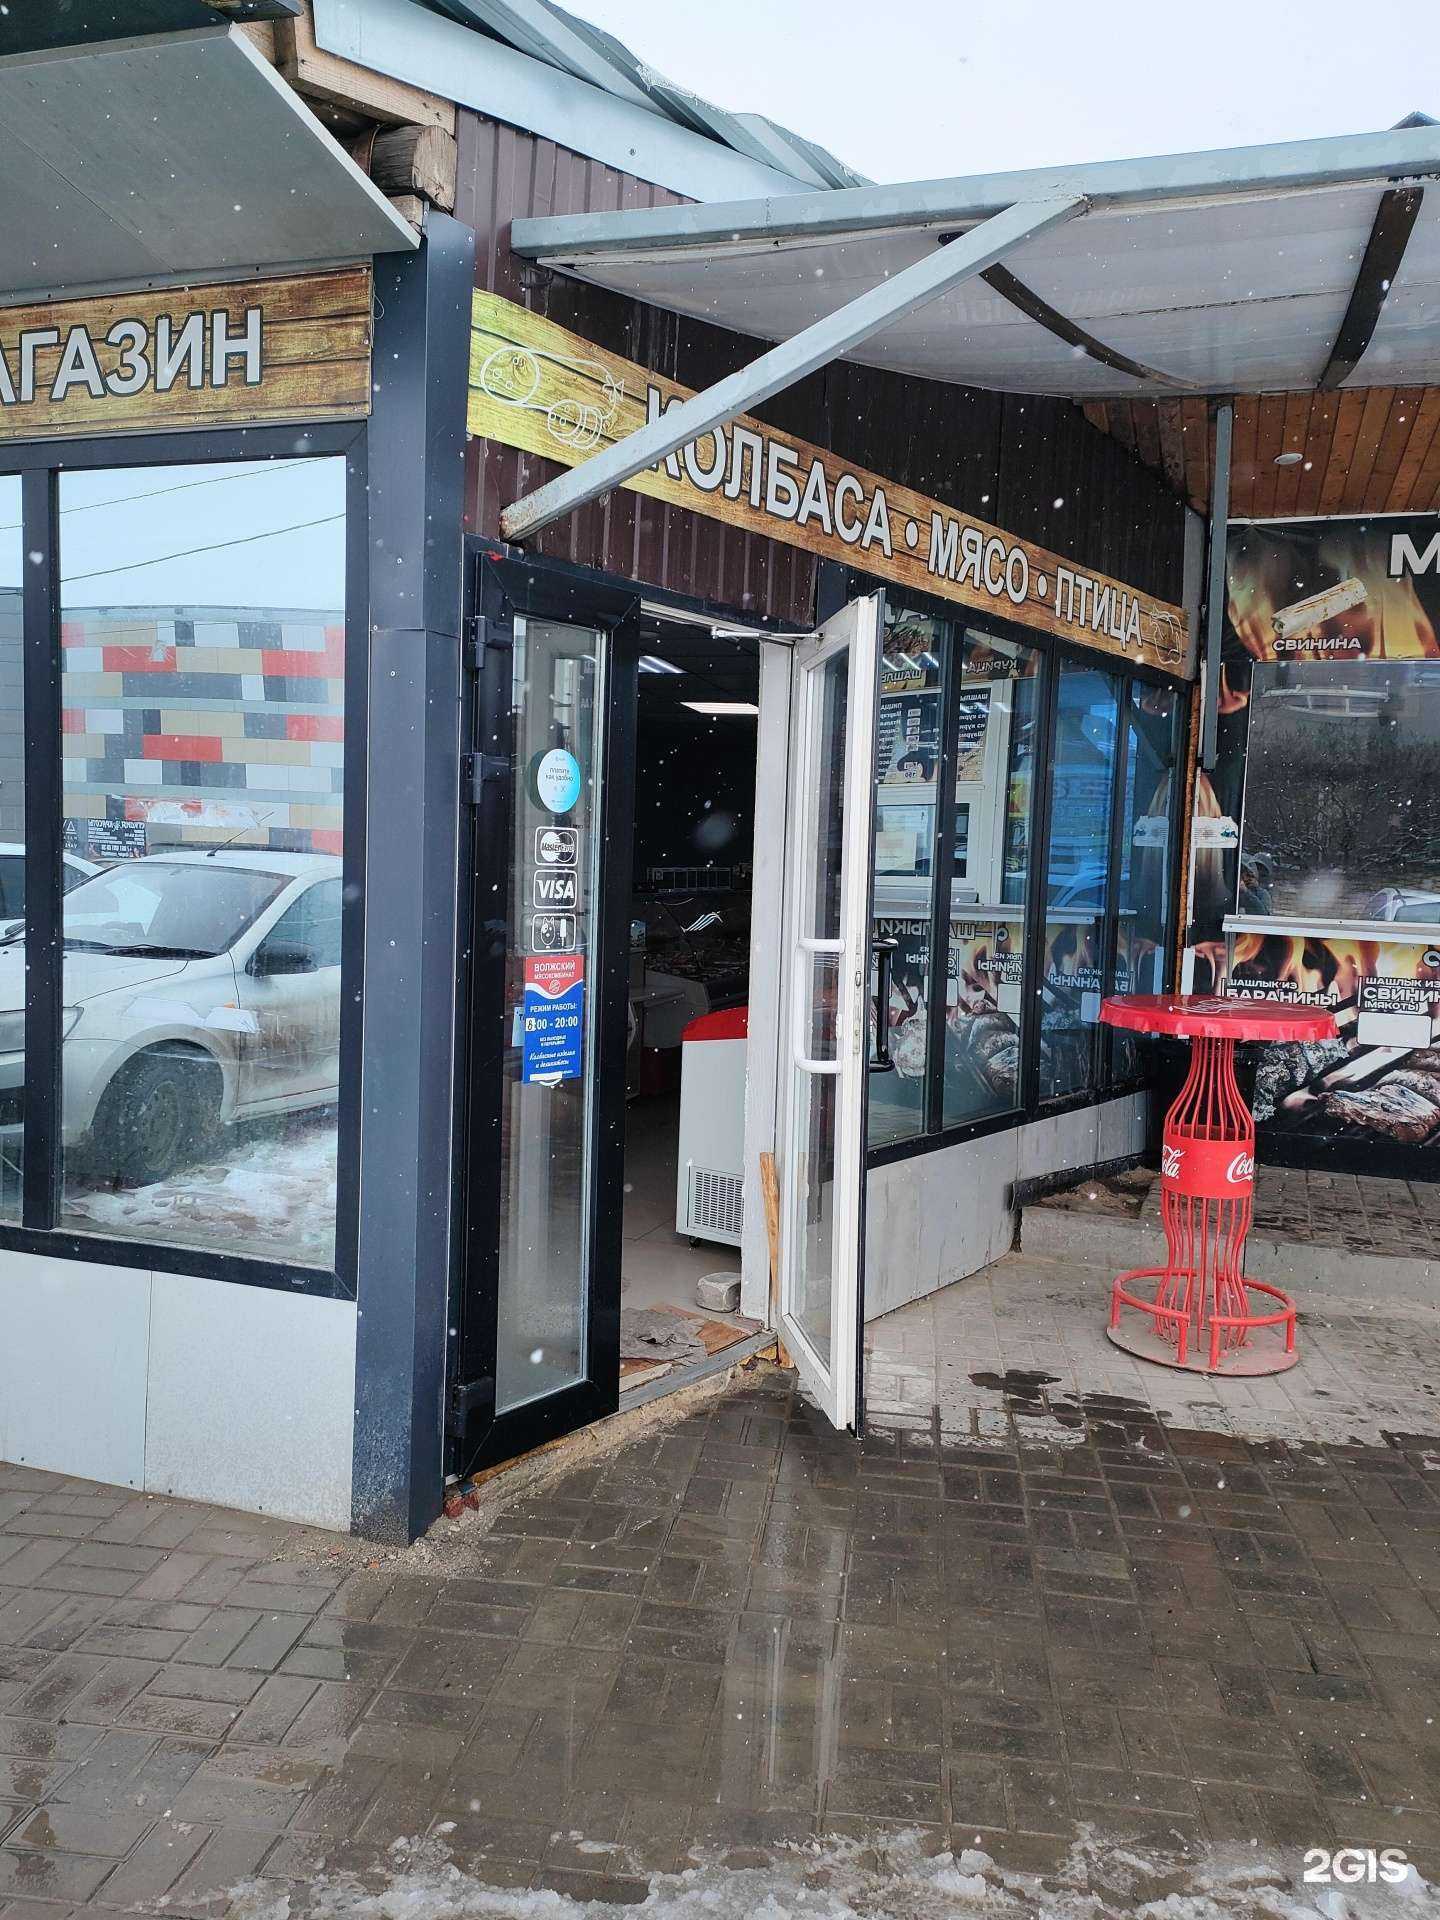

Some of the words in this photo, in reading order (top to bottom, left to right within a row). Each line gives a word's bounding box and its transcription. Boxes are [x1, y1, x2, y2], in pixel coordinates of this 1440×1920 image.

[928, 511, 1030, 604] МЯСО
[1055, 566, 1143, 650] ПТИЦА
[1272, 637, 1362, 652] СВИНИНА
[536, 880, 575, 899] VISA
[1282, 981, 1298, 990] ИЗ
[1365, 976, 1422, 988] ШАШЛЫК
[1227, 988, 1337, 1006] БАРАНИНЫ
[530, 1004, 551, 1013] РЕЖИМ
[555, 1016, 578, 1028] 20:00
